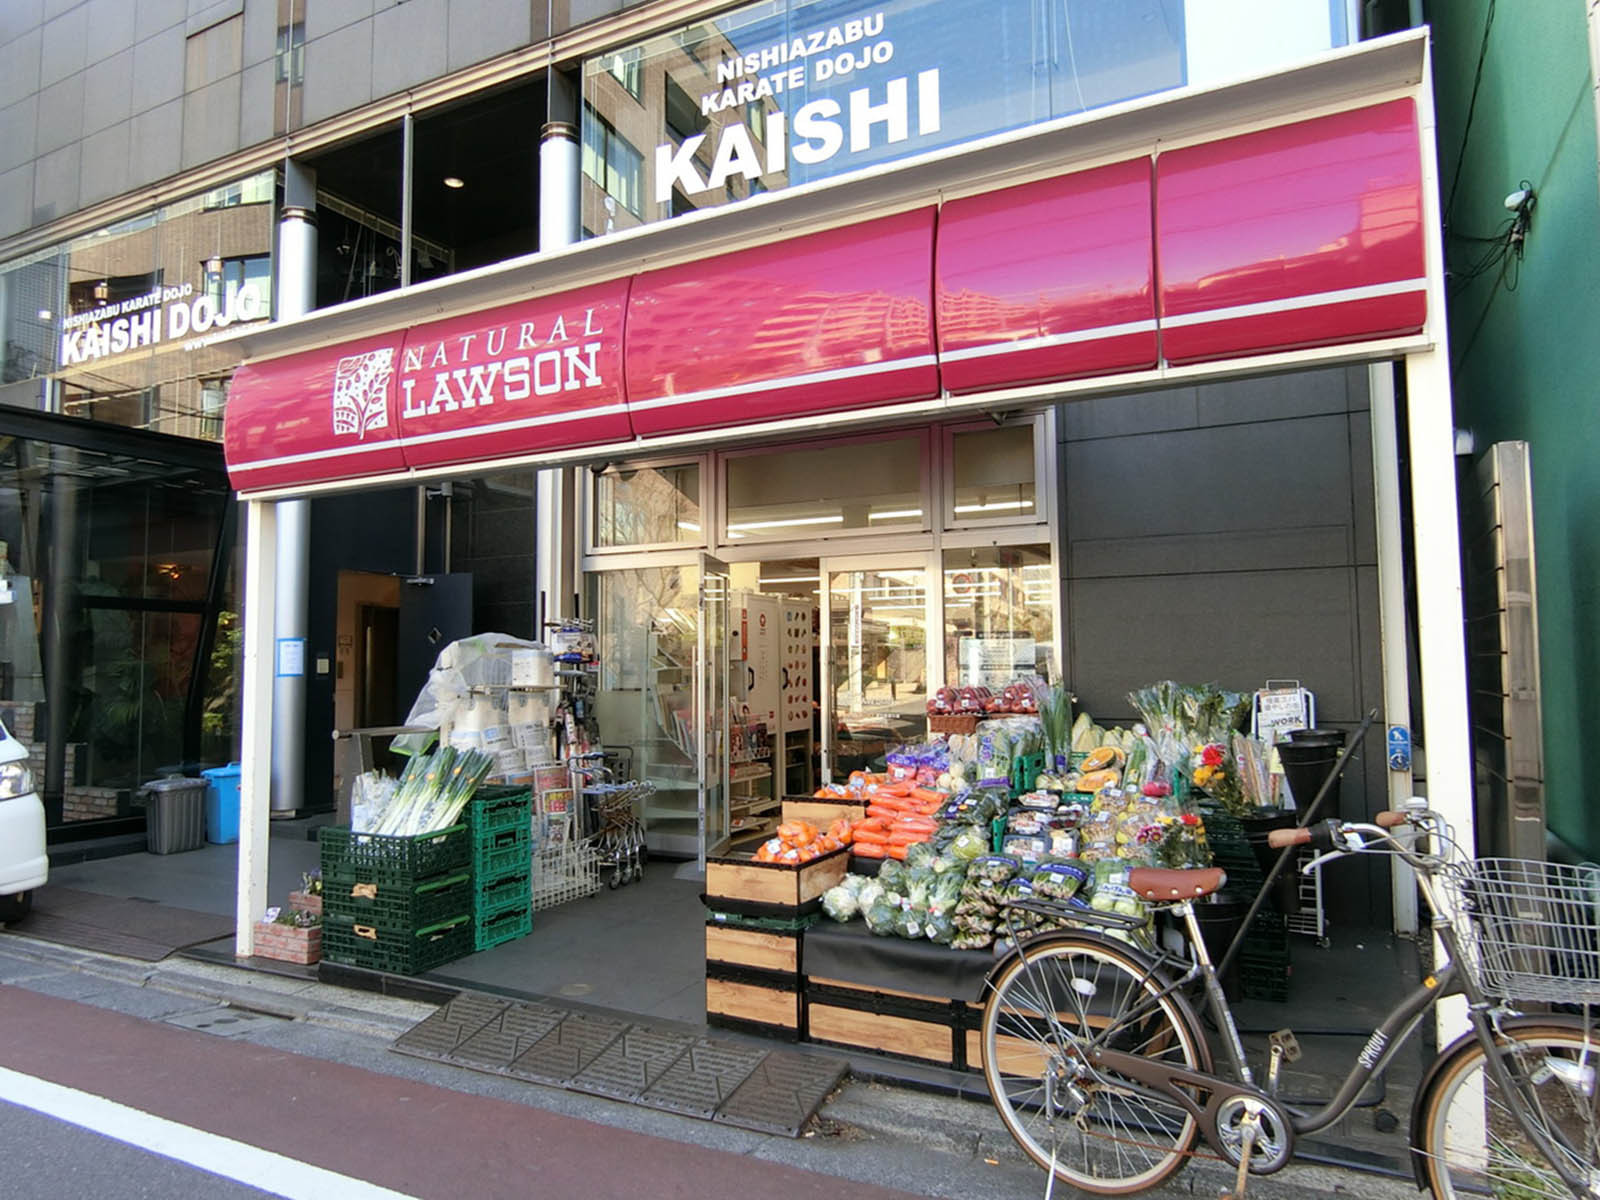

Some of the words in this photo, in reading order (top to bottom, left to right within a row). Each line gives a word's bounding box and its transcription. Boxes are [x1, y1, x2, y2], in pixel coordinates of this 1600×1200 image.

[702, 66, 805, 116] KARATE
[815, 41, 894, 82] DOJO
[717, 13, 885, 83] NISHIAZABU
[656, 68, 941, 203] KAISHI
[62, 309, 161, 366] KAISHI
[169, 284, 261, 340] DOJO
[63, 303, 121, 330] NISHIAZABU
[121, 291, 161, 314] KARATE
[163, 283, 193, 301] DOJO
[403, 308, 604, 373] NATURAL
[402, 341, 603, 419] LAWSON
[1357, 1028, 1389, 1070] SPROUT
